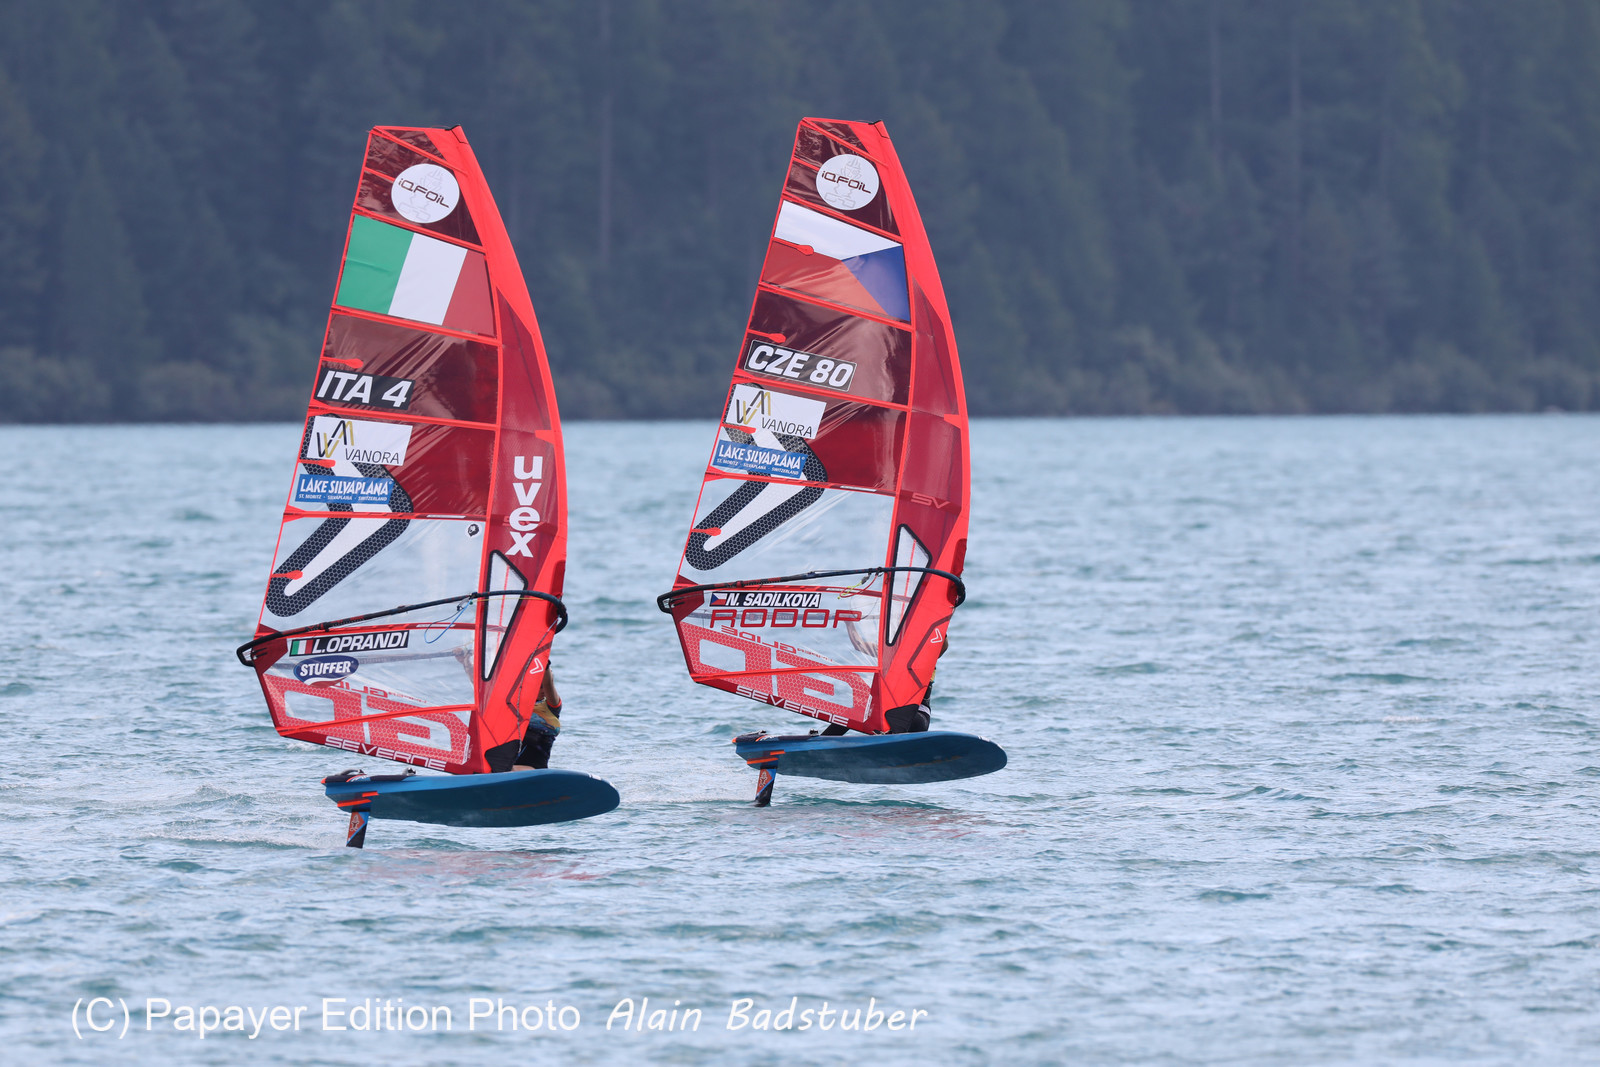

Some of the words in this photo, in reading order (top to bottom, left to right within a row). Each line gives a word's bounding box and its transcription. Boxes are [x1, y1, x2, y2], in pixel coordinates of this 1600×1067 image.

[749, 345, 810, 378] CZE
[810, 359, 854, 387] 80
[317, 370, 373, 404] ITA
[381, 380, 412, 408] 4
[761, 417, 812, 438] VANORA
[345, 448, 400, 464] VANORA
[718, 444, 746, 461] LAKE
[745, 450, 801, 470] SILVAPLANA
[300, 478, 329, 493] LAKE
[328, 480, 389, 496] SILVAPLANA
[505, 456, 543, 558] uvex
[725, 593, 739, 607] N.
[709, 608, 863, 629] RODOP
[312, 631, 408, 654] L.OPRANDI
[300, 660, 352, 677] STUFFER
[735, 685, 849, 727] SEVERNE
[324, 735, 447, 771] SEVERNE
